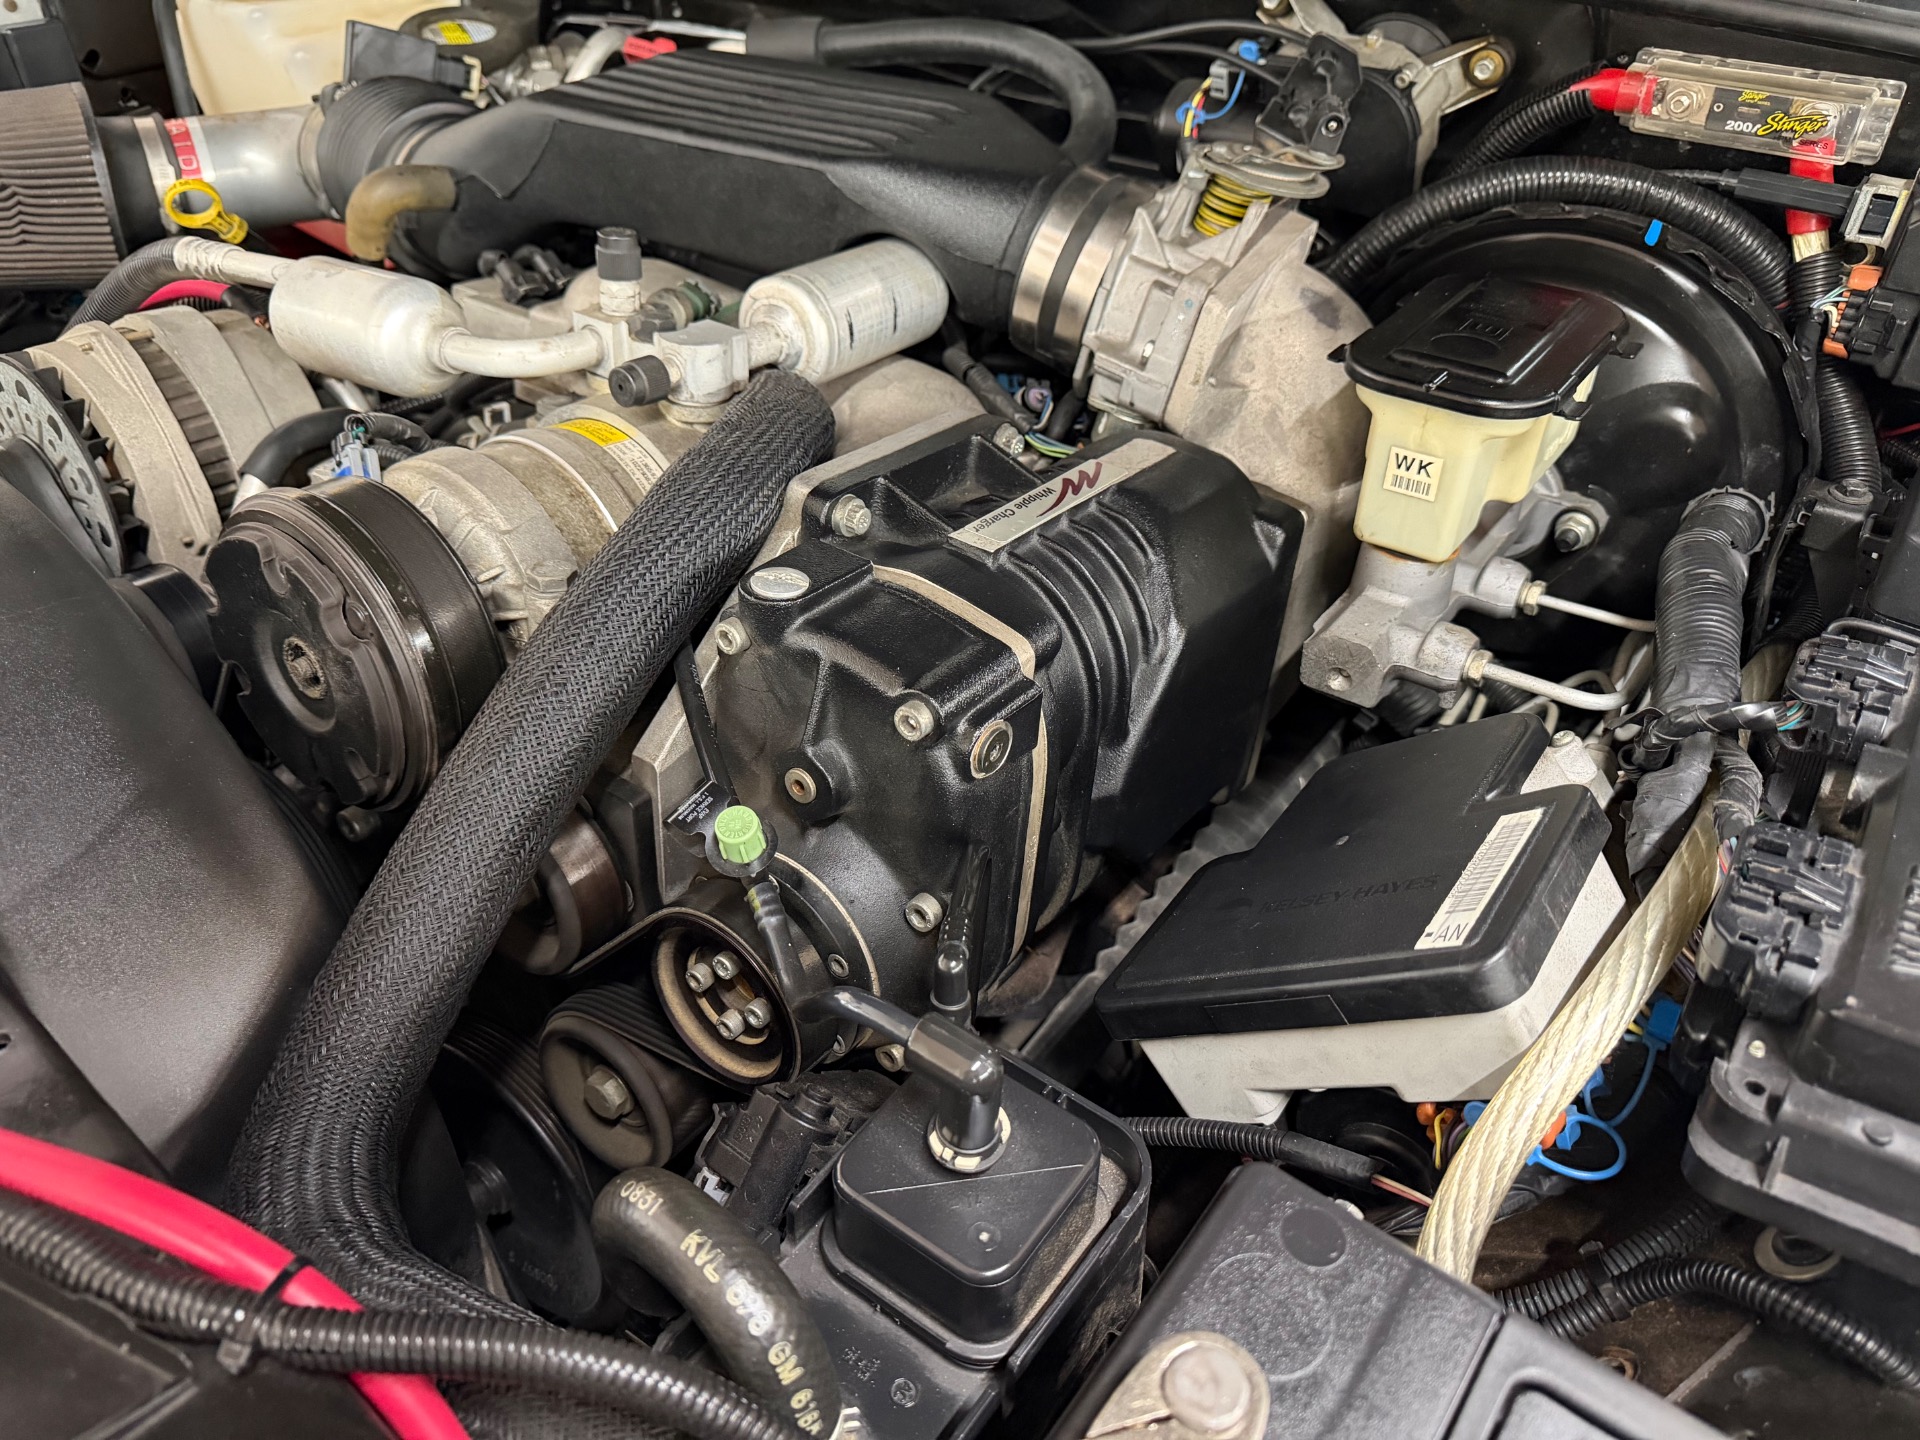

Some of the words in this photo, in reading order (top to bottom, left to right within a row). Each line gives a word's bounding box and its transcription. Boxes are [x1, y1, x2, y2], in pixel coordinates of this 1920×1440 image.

[1757, 112, 1833, 139] Stinger
[1395, 452, 1435, 479] WK
[1014, 487, 1056, 510] Whipple
[973, 508, 1016, 533] Charger
[768, 1341, 805, 1386] GM
